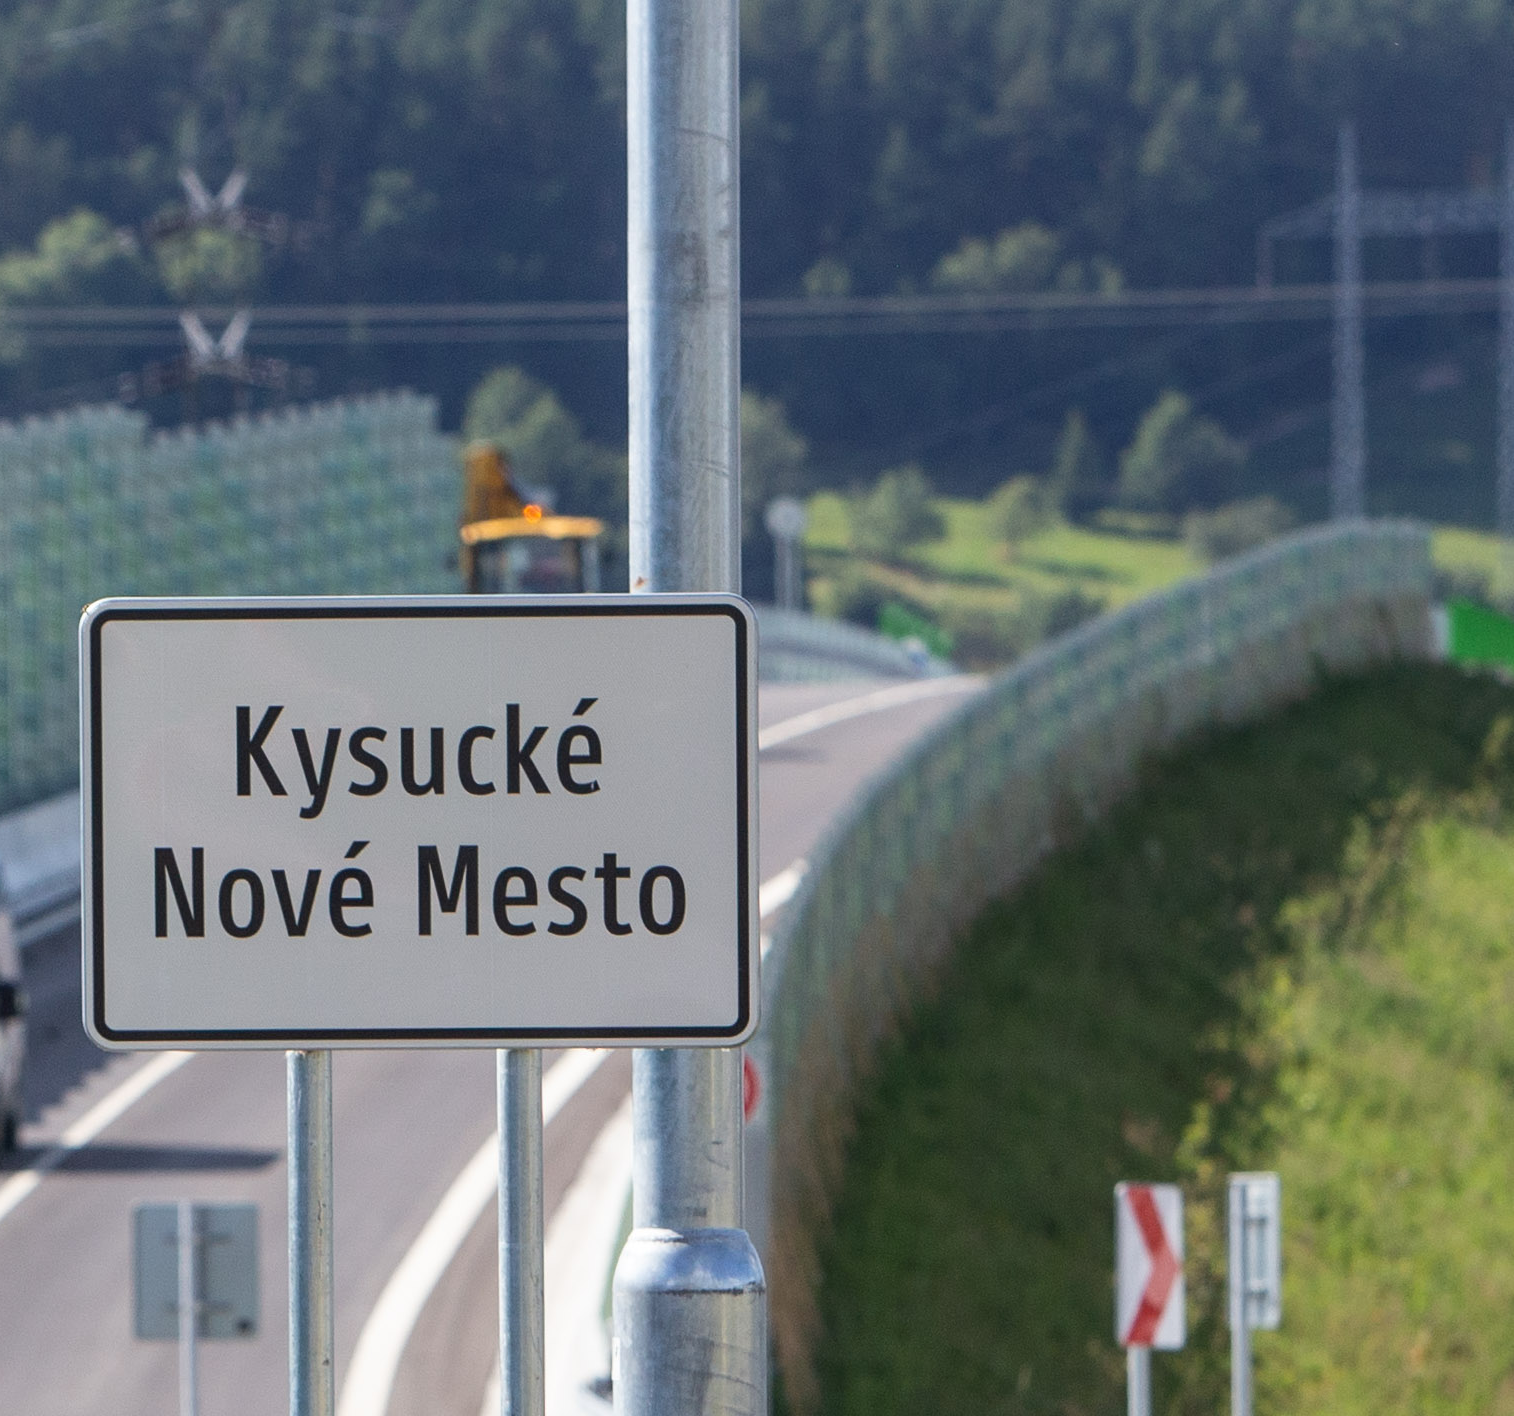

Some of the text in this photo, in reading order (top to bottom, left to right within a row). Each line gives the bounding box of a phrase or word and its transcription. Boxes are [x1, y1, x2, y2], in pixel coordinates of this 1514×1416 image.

[234, 697, 603, 820] Kysucké
[153, 840, 687, 938] Nové Mesto
